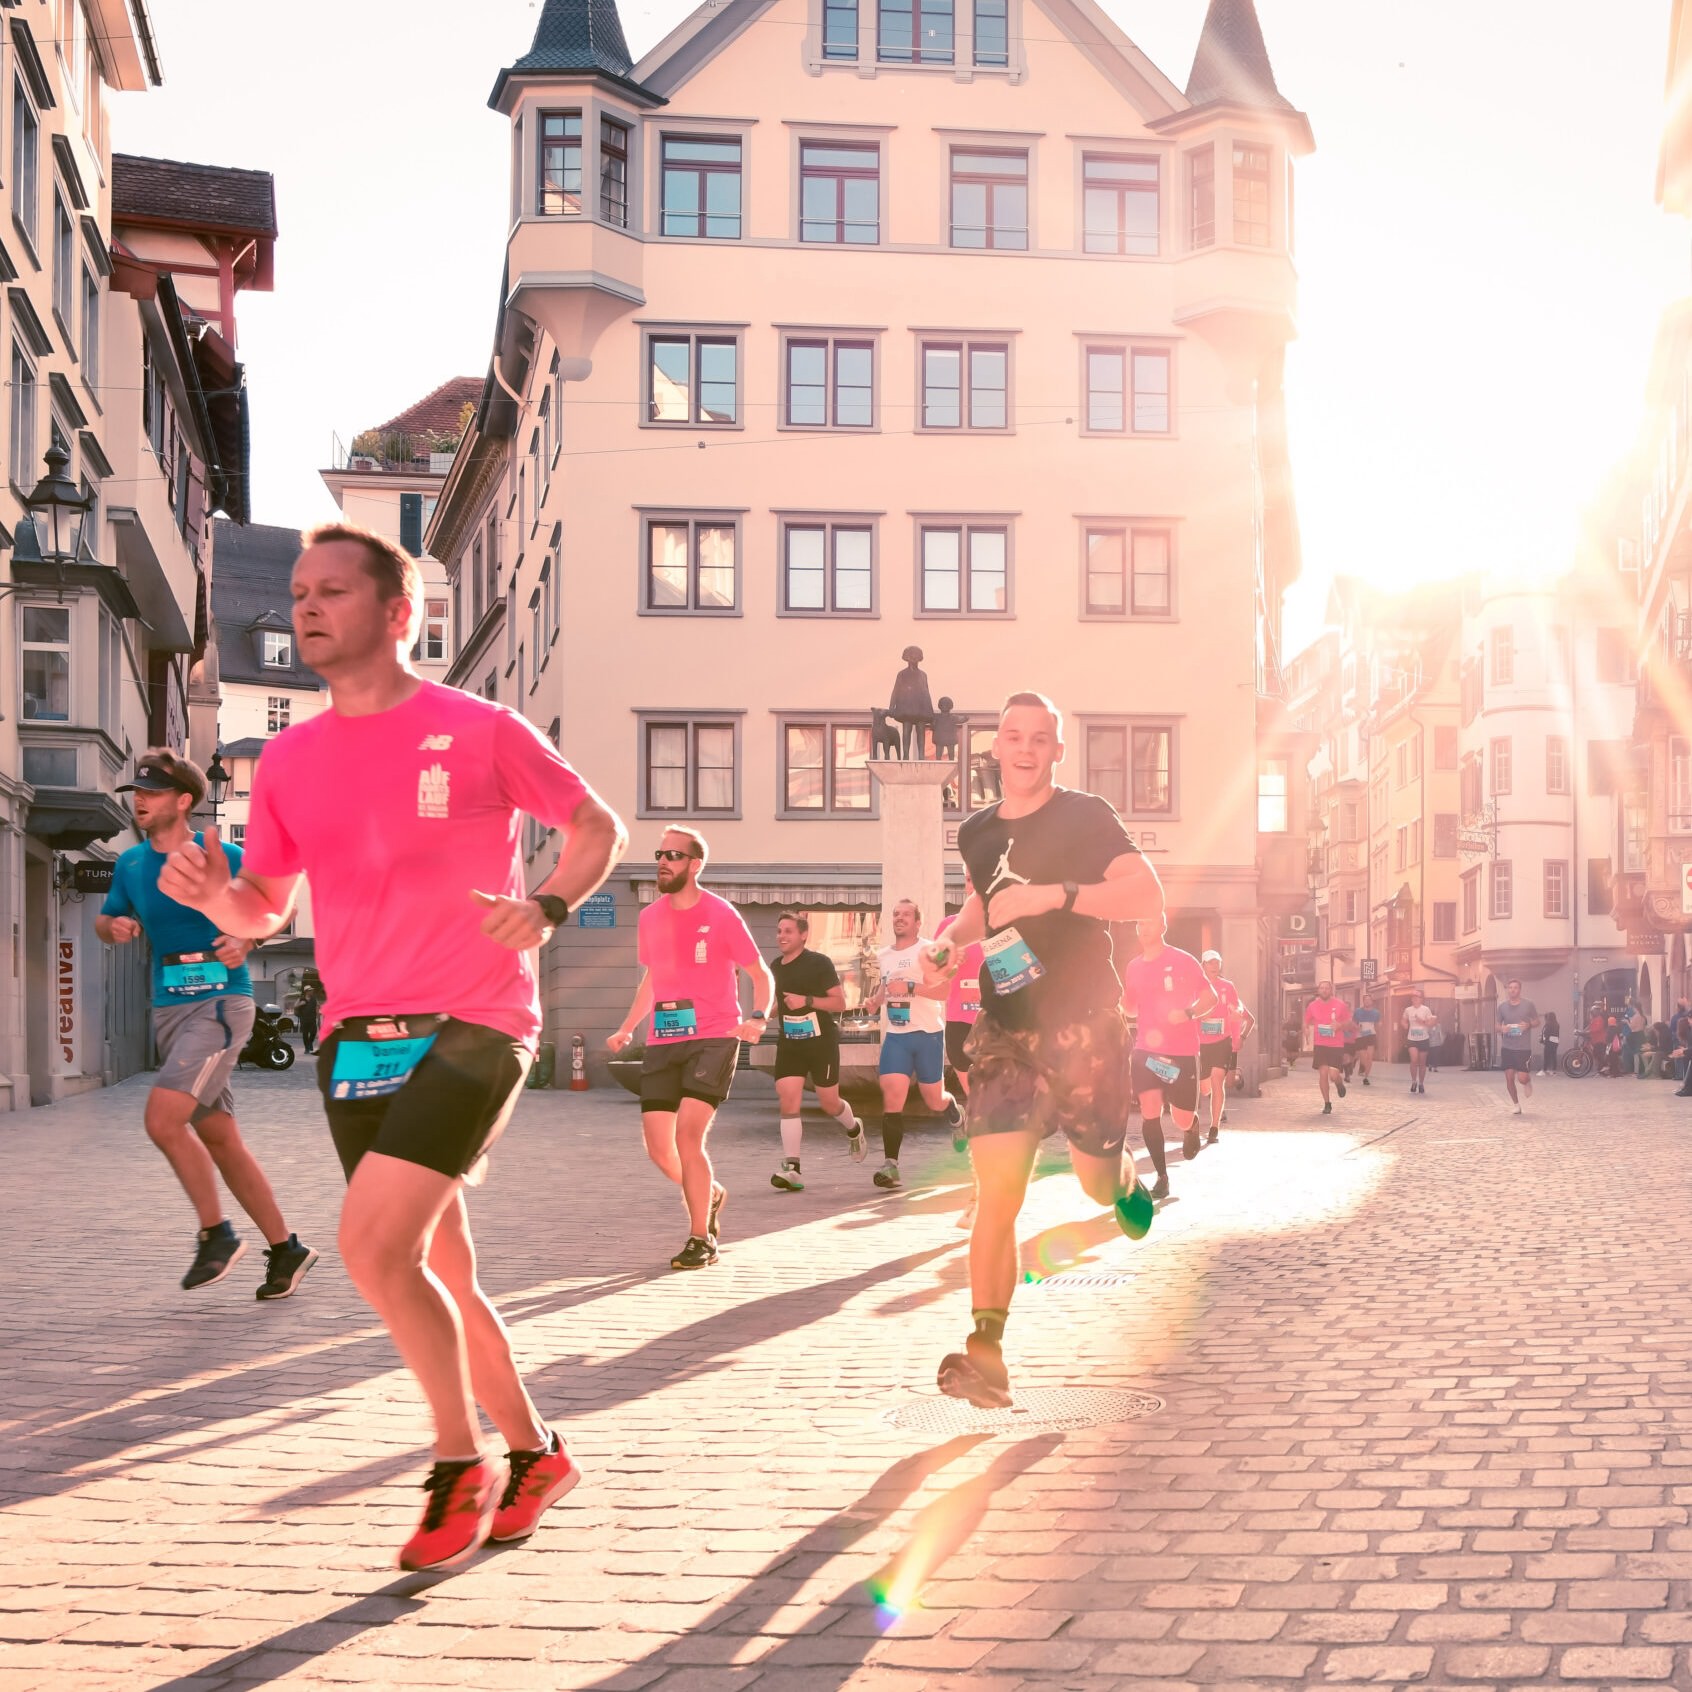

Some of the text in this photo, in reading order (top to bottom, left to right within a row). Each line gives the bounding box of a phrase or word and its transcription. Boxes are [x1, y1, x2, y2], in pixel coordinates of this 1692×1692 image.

[1290, 914, 1306, 931] D
[663, 1019, 680, 1028] 1635
[373, 1062, 400, 1077] 211
